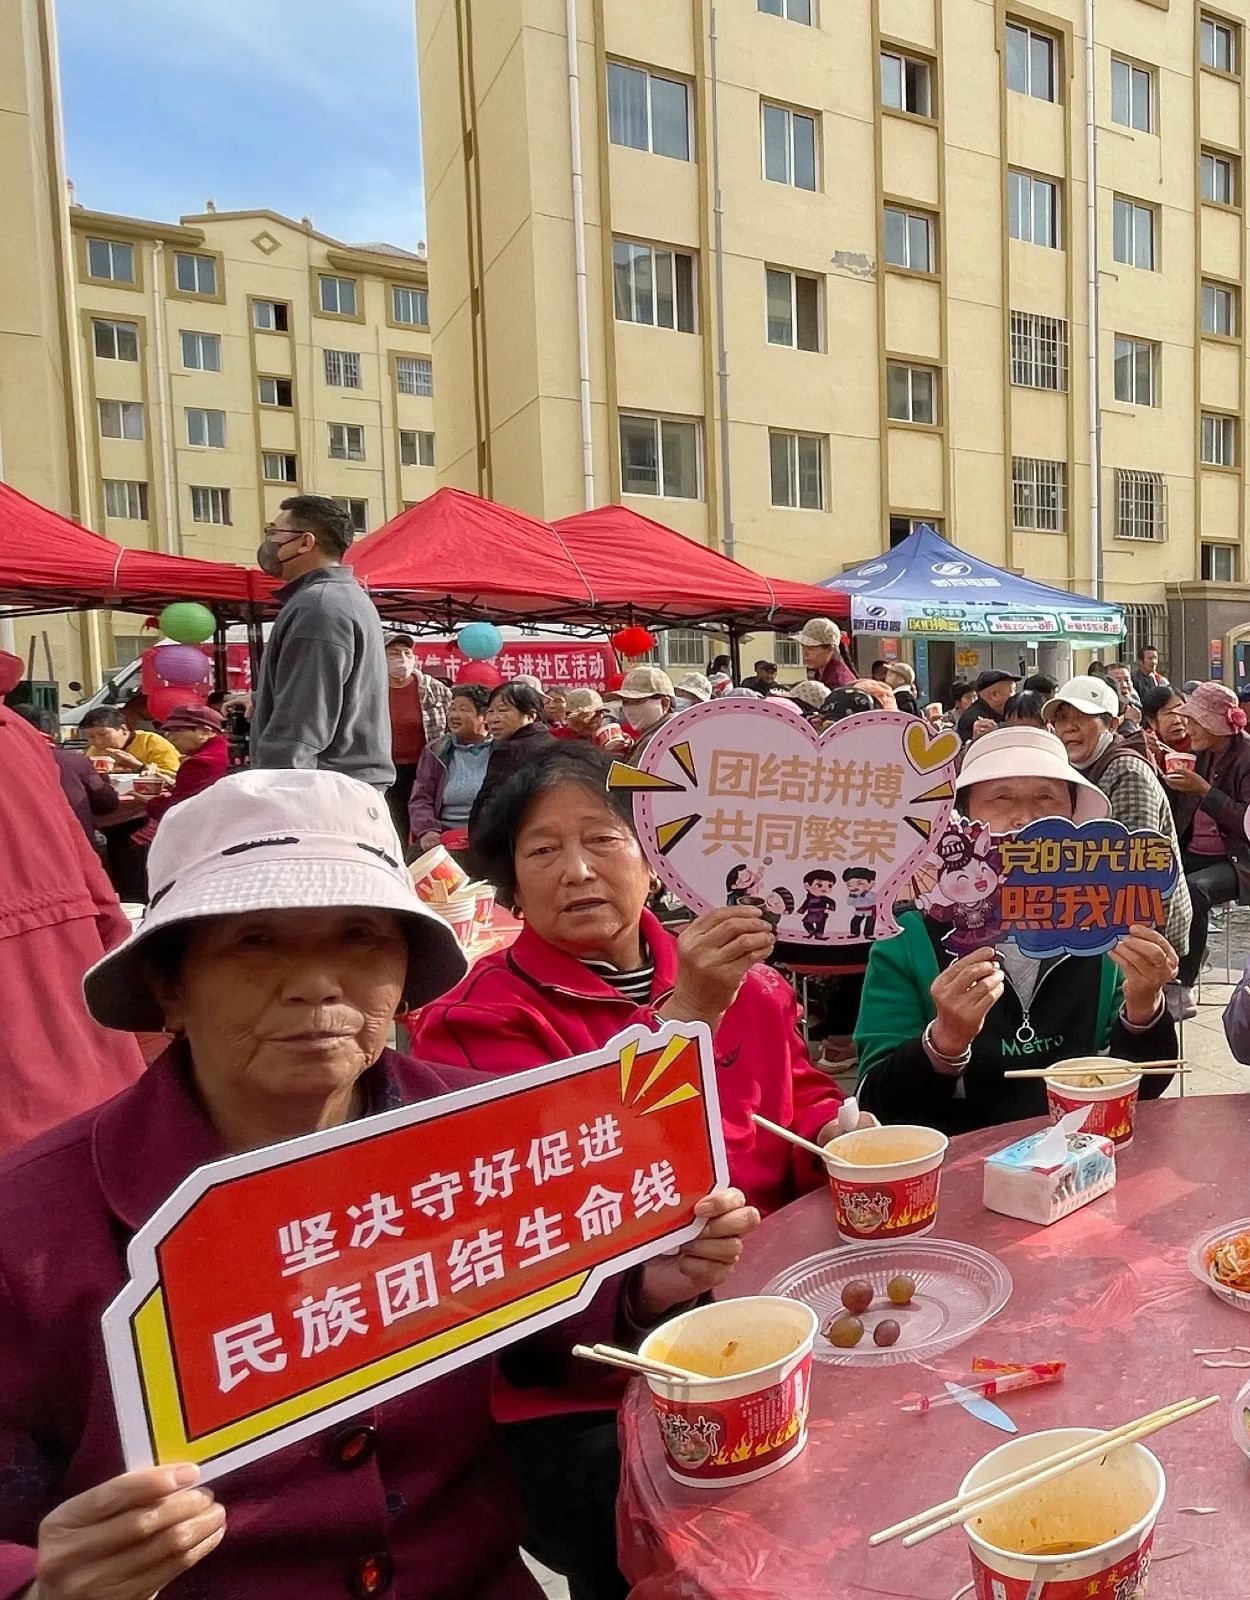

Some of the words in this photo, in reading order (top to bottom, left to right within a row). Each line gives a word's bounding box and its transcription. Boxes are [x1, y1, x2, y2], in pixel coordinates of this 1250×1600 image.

[709, 749, 905, 810] 团结拼搏
[702, 808, 898, 865] 共同繁荣
[998, 837, 1172, 875] 党的光辉
[1000, 884, 1166, 931] 照我心
[1001, 1035, 1064, 1056] Metro
[278, 1113, 625, 1278] 坚决守好促进
[212, 1159, 682, 1394] 民族团结生命线
